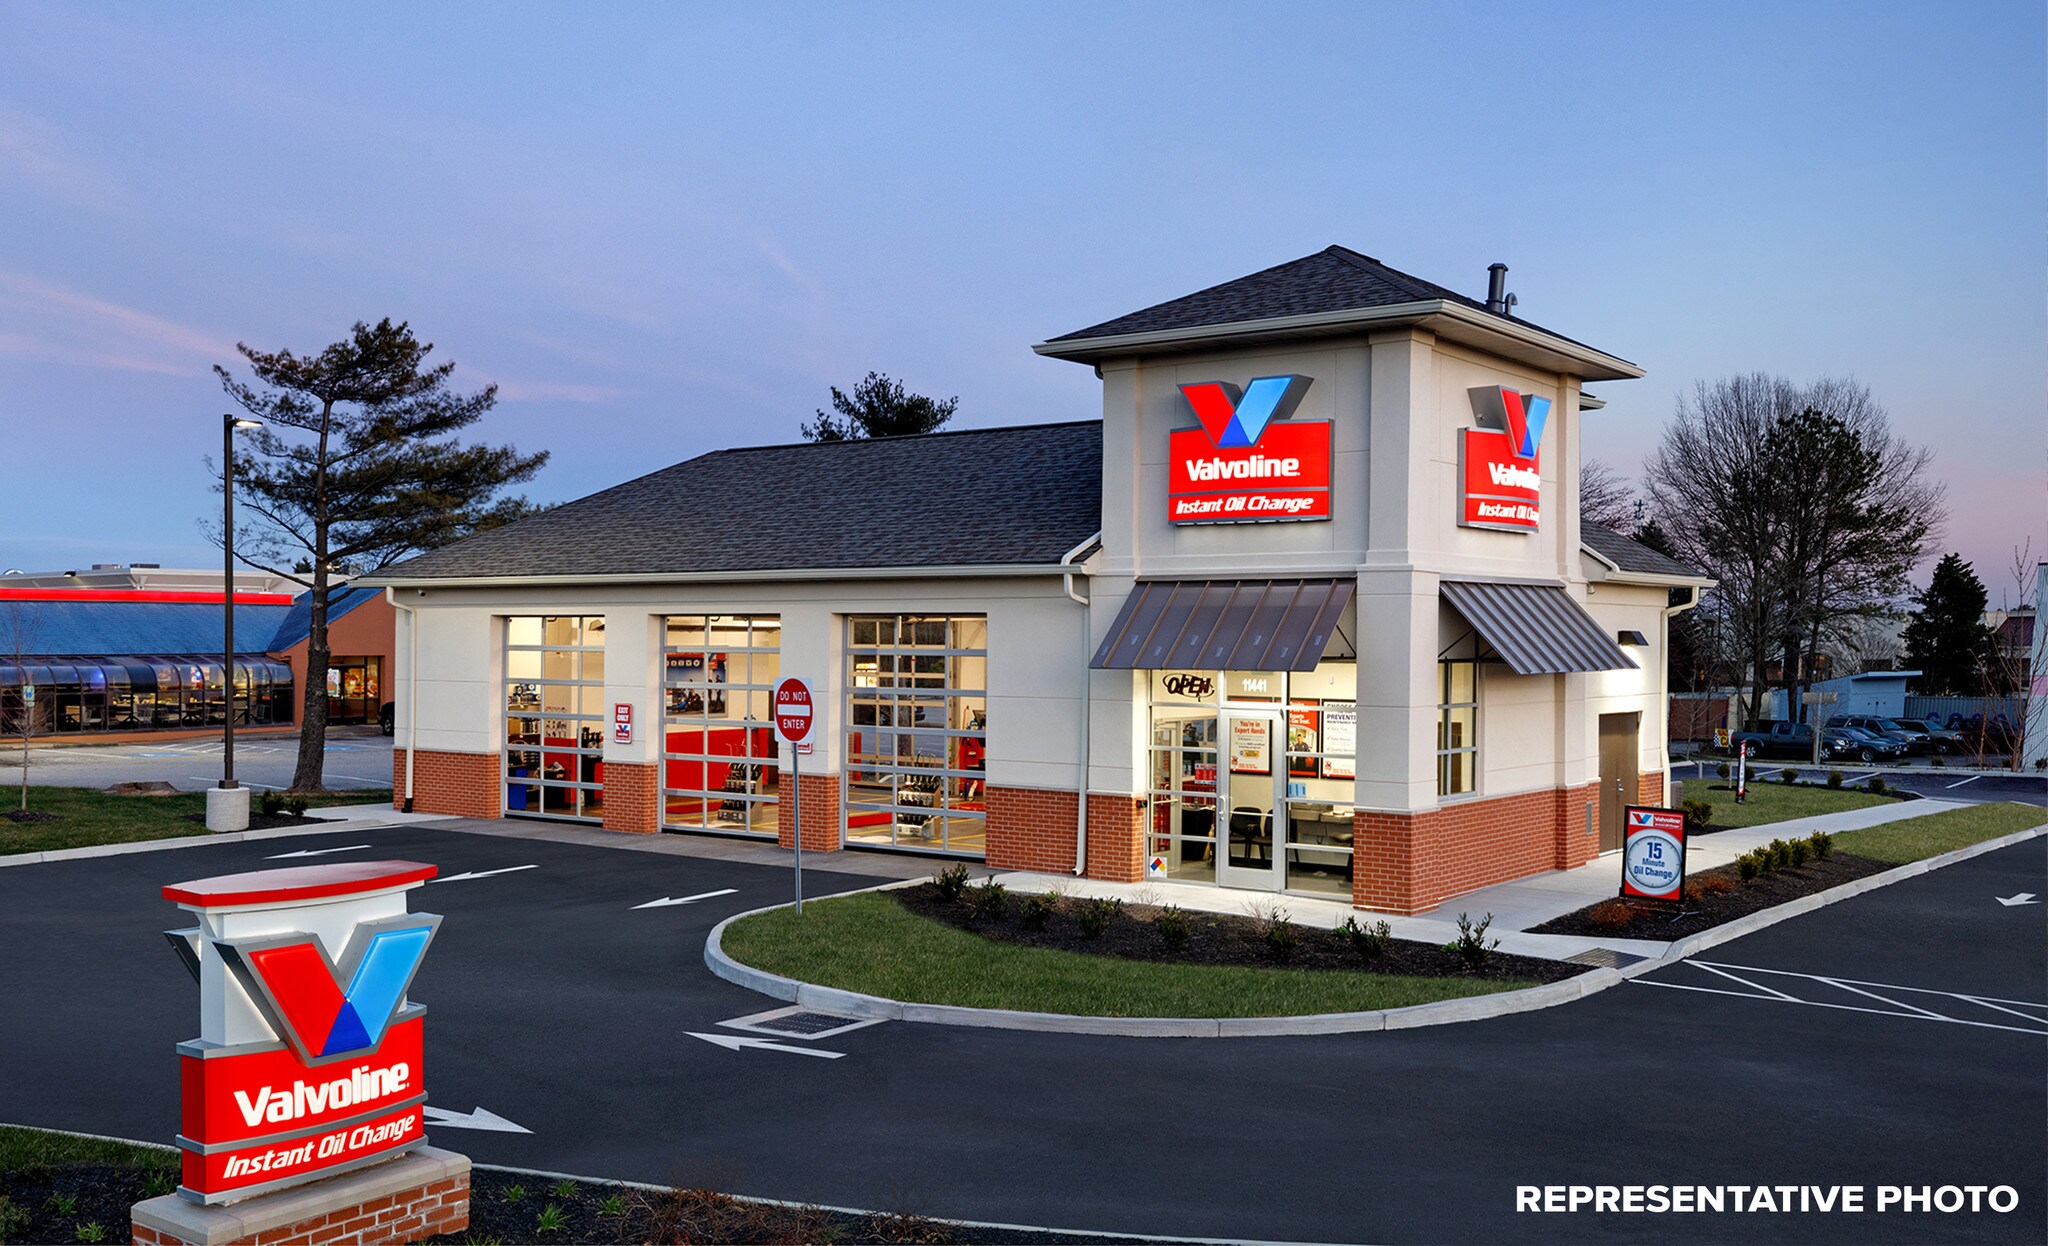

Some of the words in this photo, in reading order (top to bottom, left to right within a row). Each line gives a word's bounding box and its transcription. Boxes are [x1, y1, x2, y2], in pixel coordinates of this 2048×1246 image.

[1185, 455, 1300, 481] Valvoline
[1176, 498, 1223, 514] Instant
[1224, 497, 1247, 511] Oil
[1247, 496, 1314, 513] Change
[1477, 501, 1517, 519] Instant
[1166, 674, 1211, 695] OPEN
[1242, 678, 1267, 692] 11441
[780, 691, 790, 701] DO
[792, 691, 807, 702] NOT
[782, 719, 805, 729] ENTER
[1327, 713, 1356, 721] PREVENTI
[1647, 841, 1662, 859] 15
[1642, 858, 1665, 867] Minute
[1634, 865, 1644, 875] Oil
[1645, 867, 1673, 879] Change
[233, 1062, 410, 1127] Valvoline
[223, 1141, 315, 1179] Instant
[317, 1132, 347, 1159] Oil
[349, 1114, 416, 1150] Change
